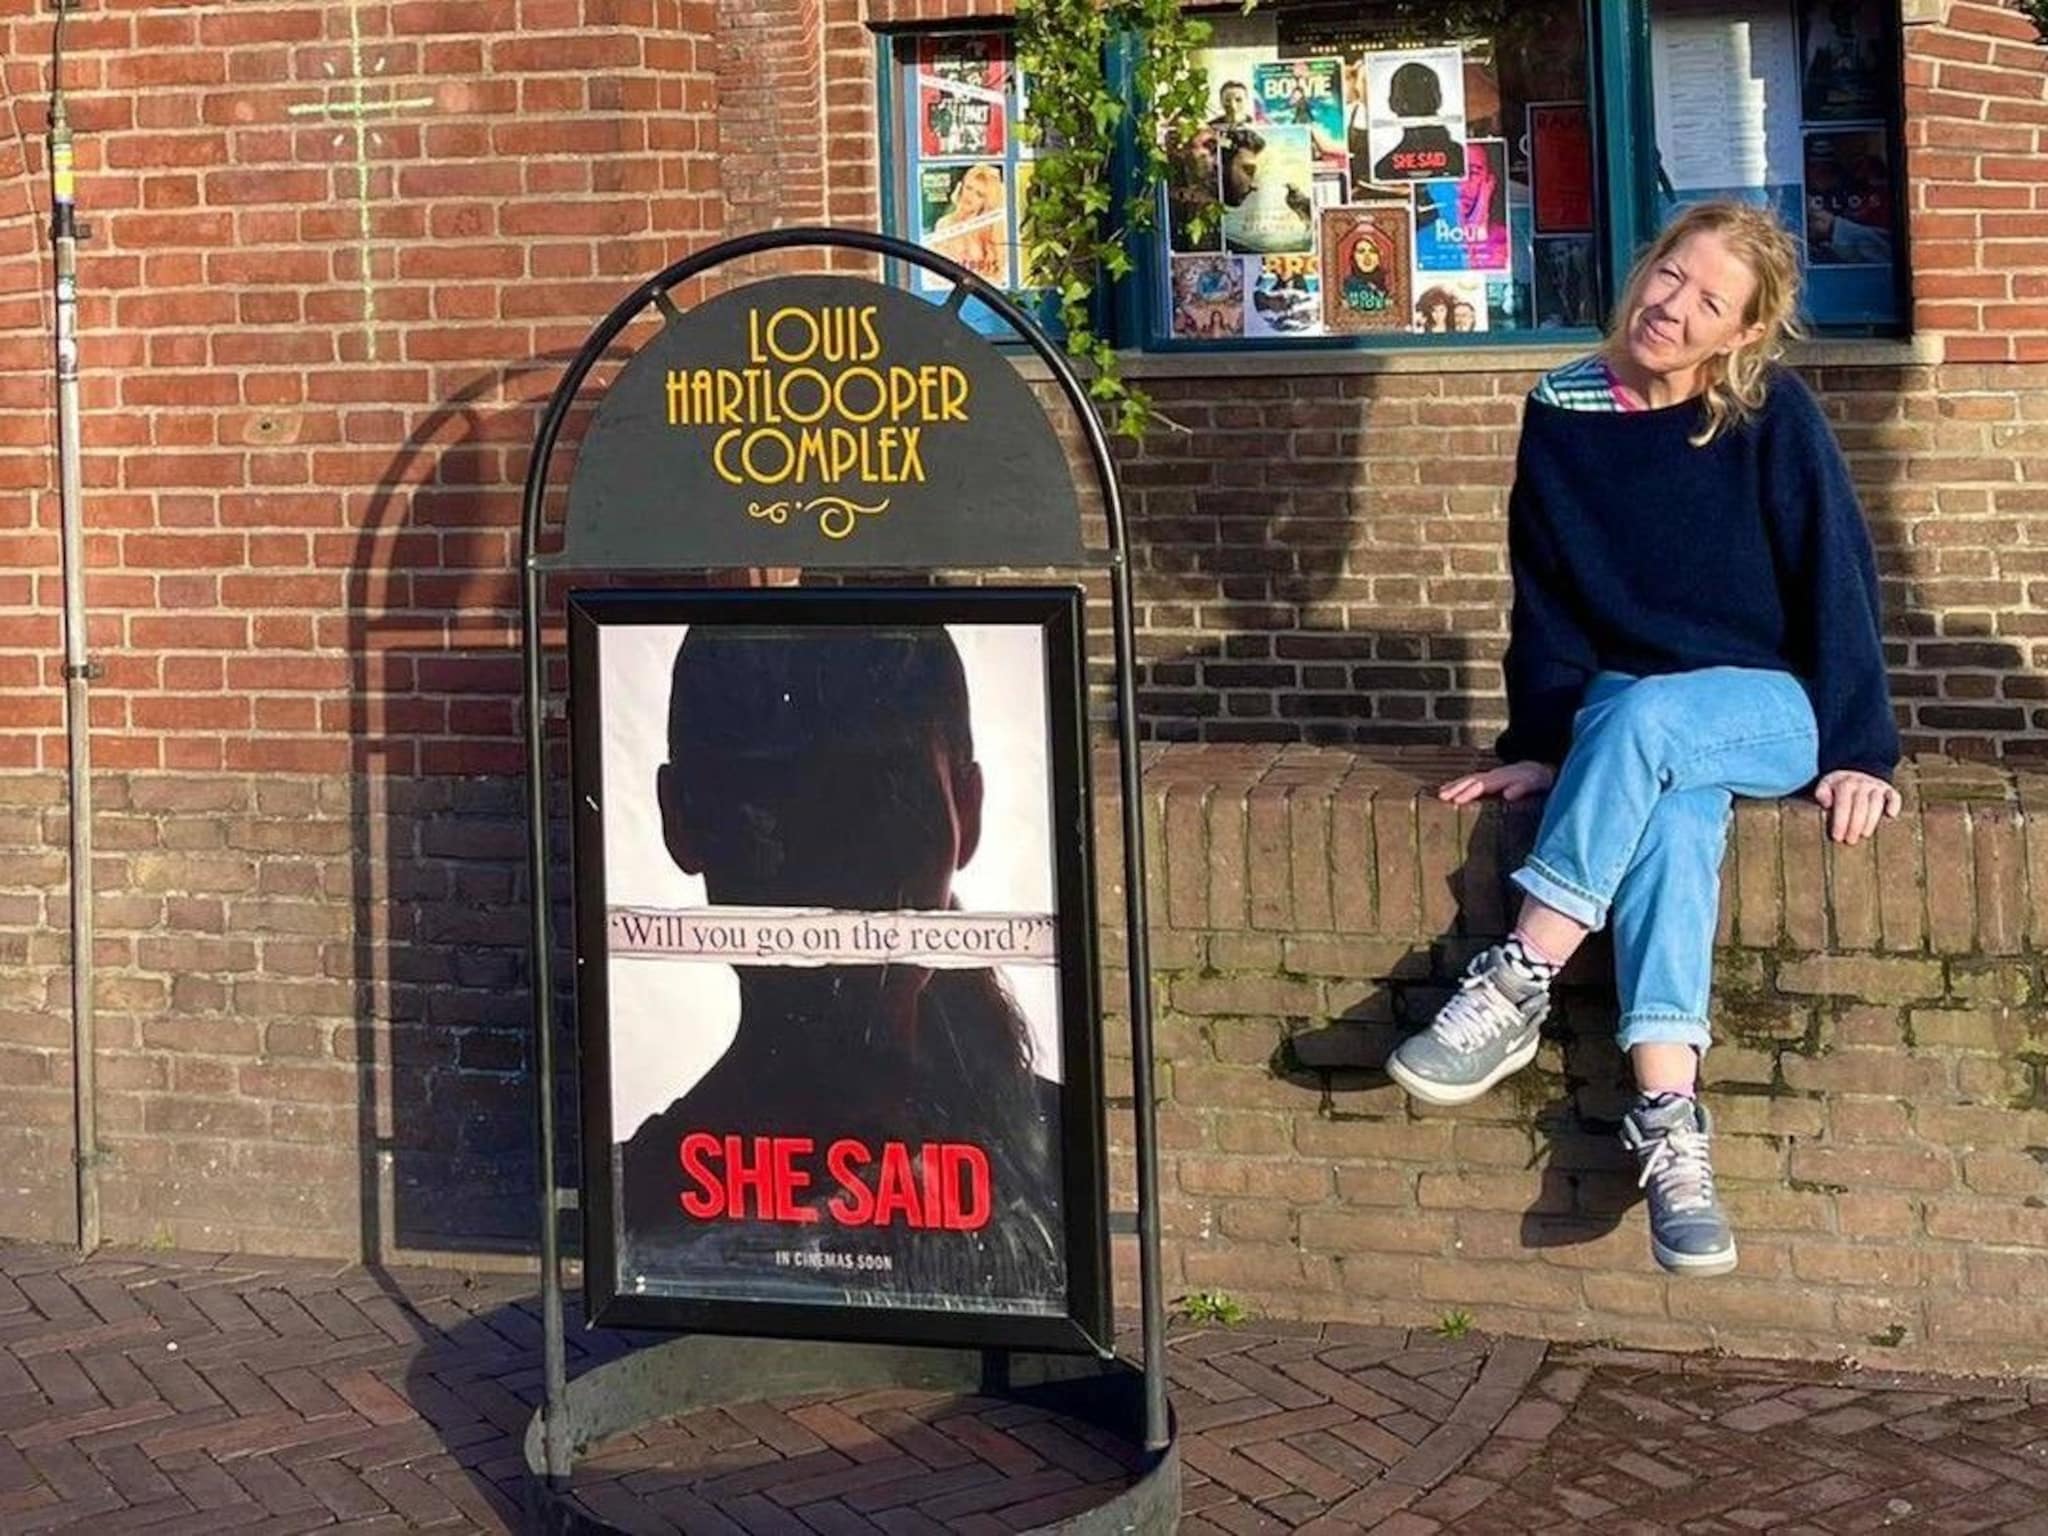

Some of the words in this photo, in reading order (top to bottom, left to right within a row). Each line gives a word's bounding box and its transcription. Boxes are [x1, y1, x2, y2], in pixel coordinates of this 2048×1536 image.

[749, 306, 881, 363] LOUIS
[665, 365, 969, 425] HARTLOOPER
[713, 426, 926, 485] COMPLEX
[692, 926, 746, 954] you
[756, 927, 795, 957] go
[803, 927, 840, 950] on
[853, 919, 901, 950] the
[679, 1132, 820, 1223] SHE
[826, 1138, 992, 1231] SAID
[775, 1250, 790, 1266] IN
[794, 1251, 854, 1270] CINEMAS
[857, 1253, 893, 1271] SOON
